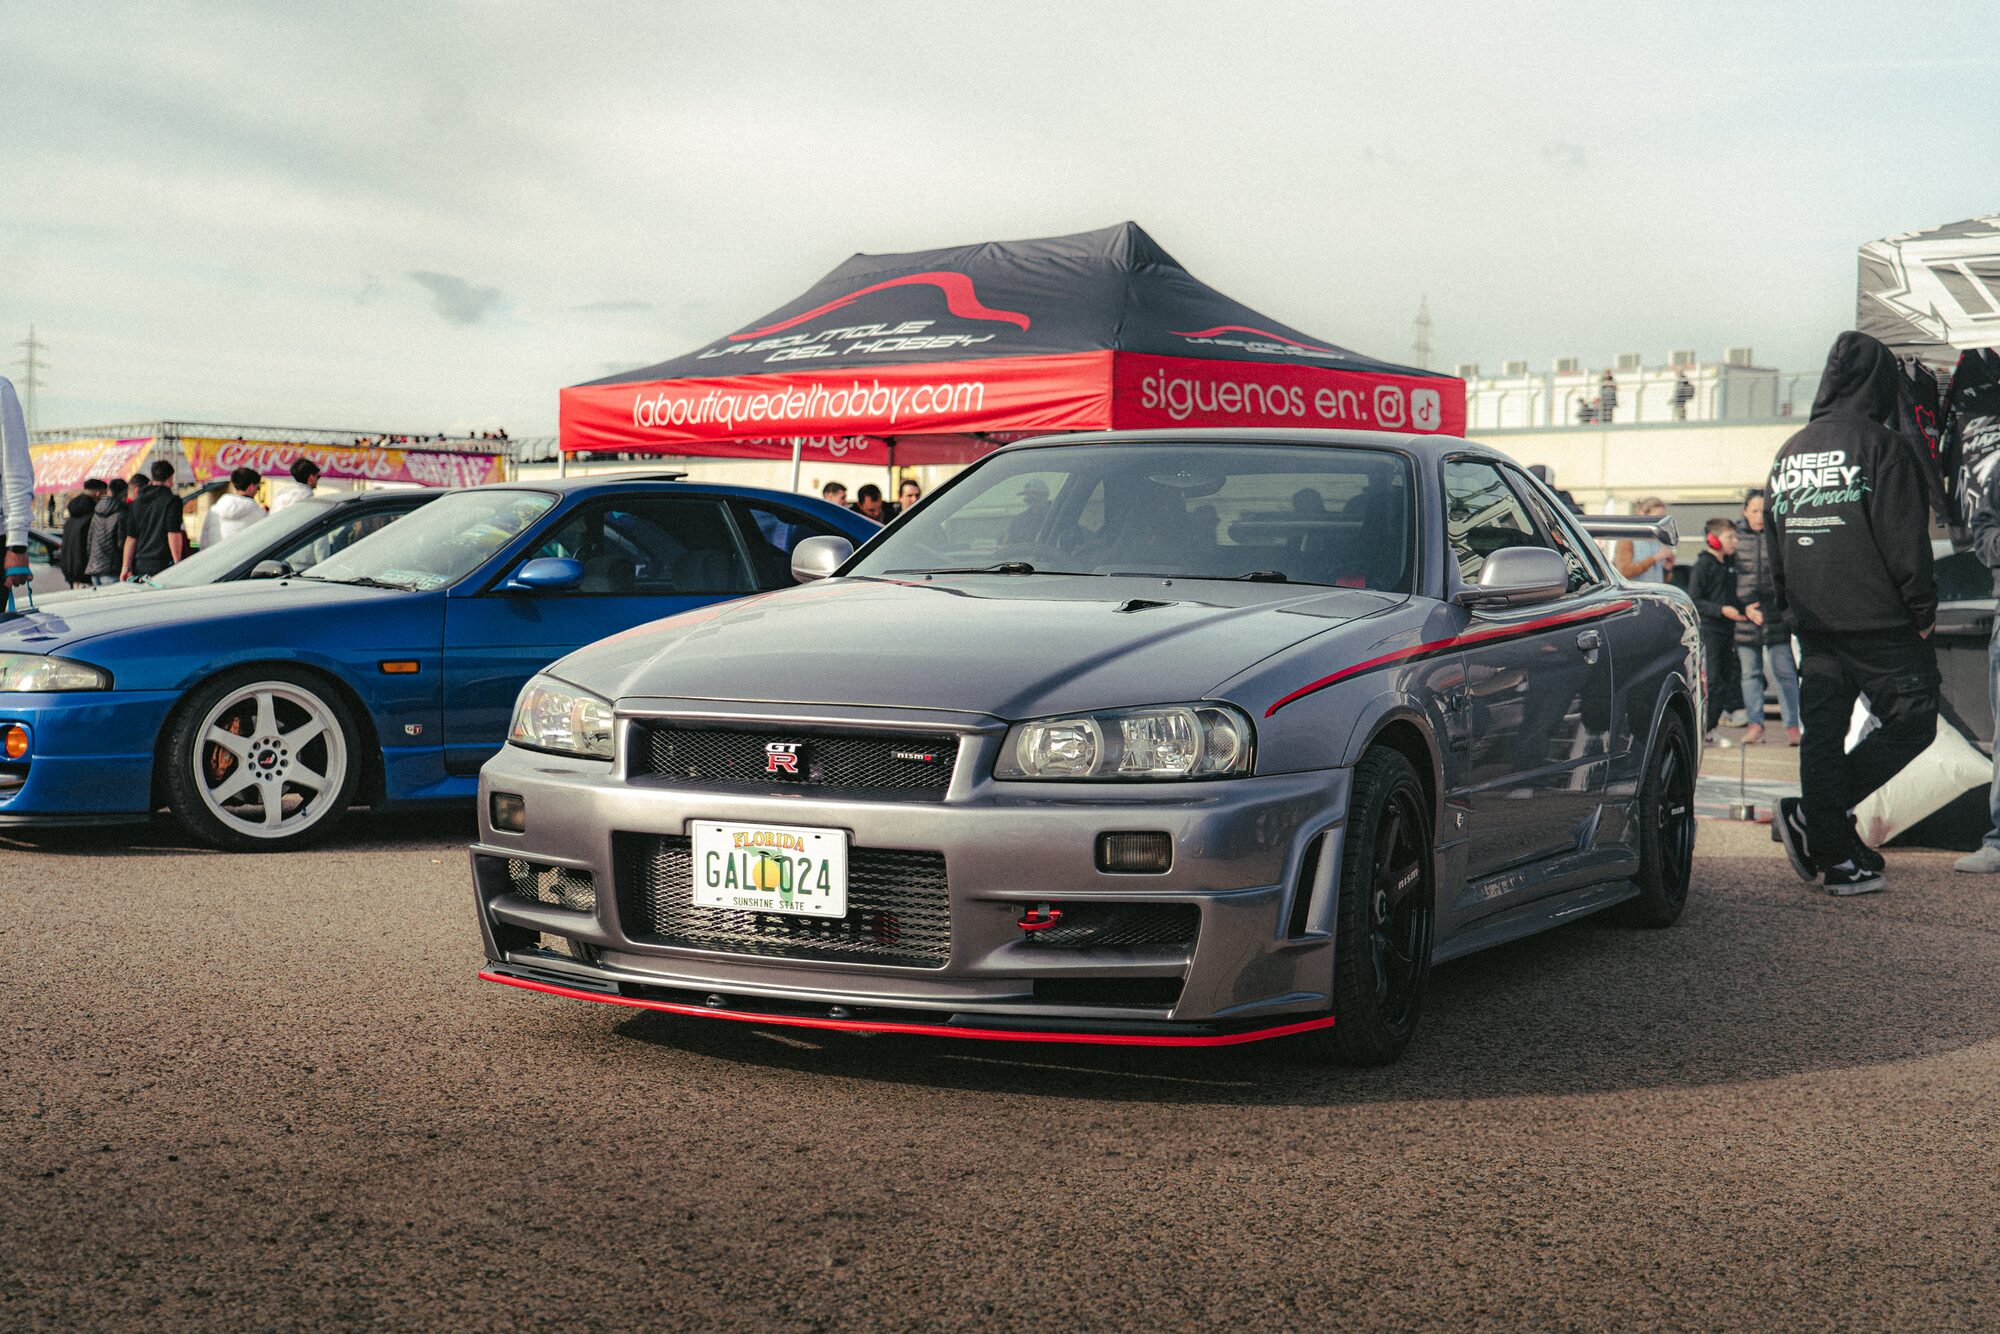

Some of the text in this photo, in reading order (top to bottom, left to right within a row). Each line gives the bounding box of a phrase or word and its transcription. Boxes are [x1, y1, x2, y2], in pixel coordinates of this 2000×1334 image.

[745, 319, 937, 353] BOUTIQUE
[763, 333, 997, 364] DEL HOBBY
[633, 380, 985, 430] laboutiquedelhobby.com
[1141, 368, 1369, 421] siguenos en:
[1786, 450, 1846, 470] NEED
[1770, 466, 1862, 495] MONEY
[1789, 481, 1862, 514] Porsche
[765, 742, 802, 753] GT
[766, 752, 798, 773] R
[732, 831, 805, 853] FLORIDA
[733, 896, 805, 911] SUNSHINE STATE
